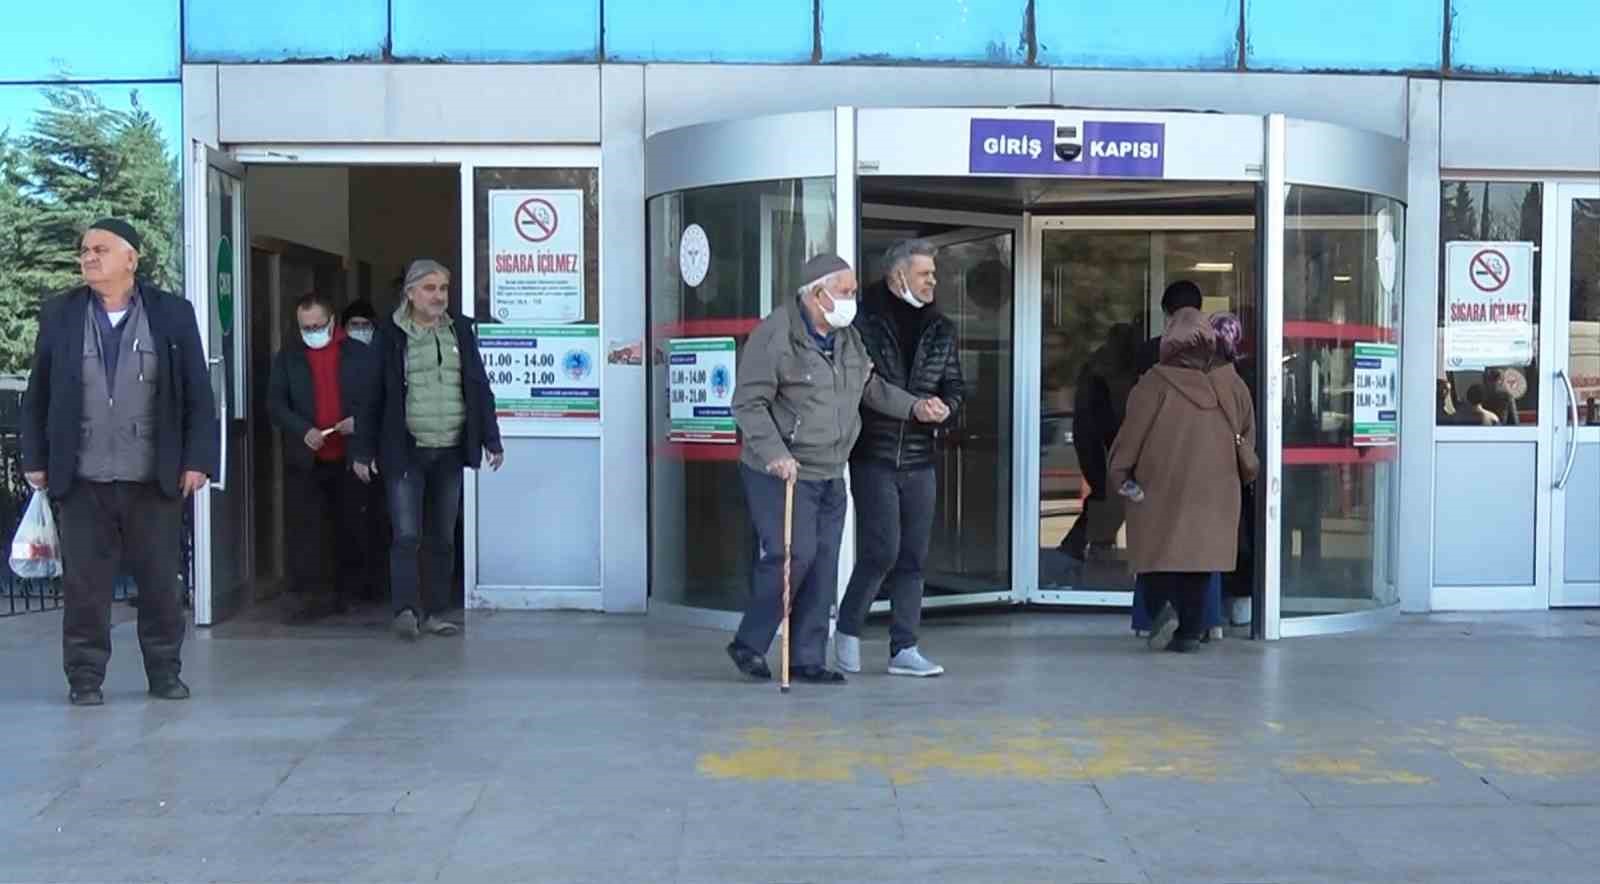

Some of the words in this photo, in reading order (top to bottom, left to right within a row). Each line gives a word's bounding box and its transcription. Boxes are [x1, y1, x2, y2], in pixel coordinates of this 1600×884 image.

[983, 135, 1042, 159] GİRİŞ
[1090, 141, 1158, 159] KAPISI
[495, 249, 535, 273] SİGARA
[537, 249, 578, 276] İÇİLMEZ
[1450, 298, 1487, 322] SİGARA
[524, 353, 555, 367] 14.00
[488, 370, 513, 384] 8.00
[524, 371, 555, 385] 21.00
